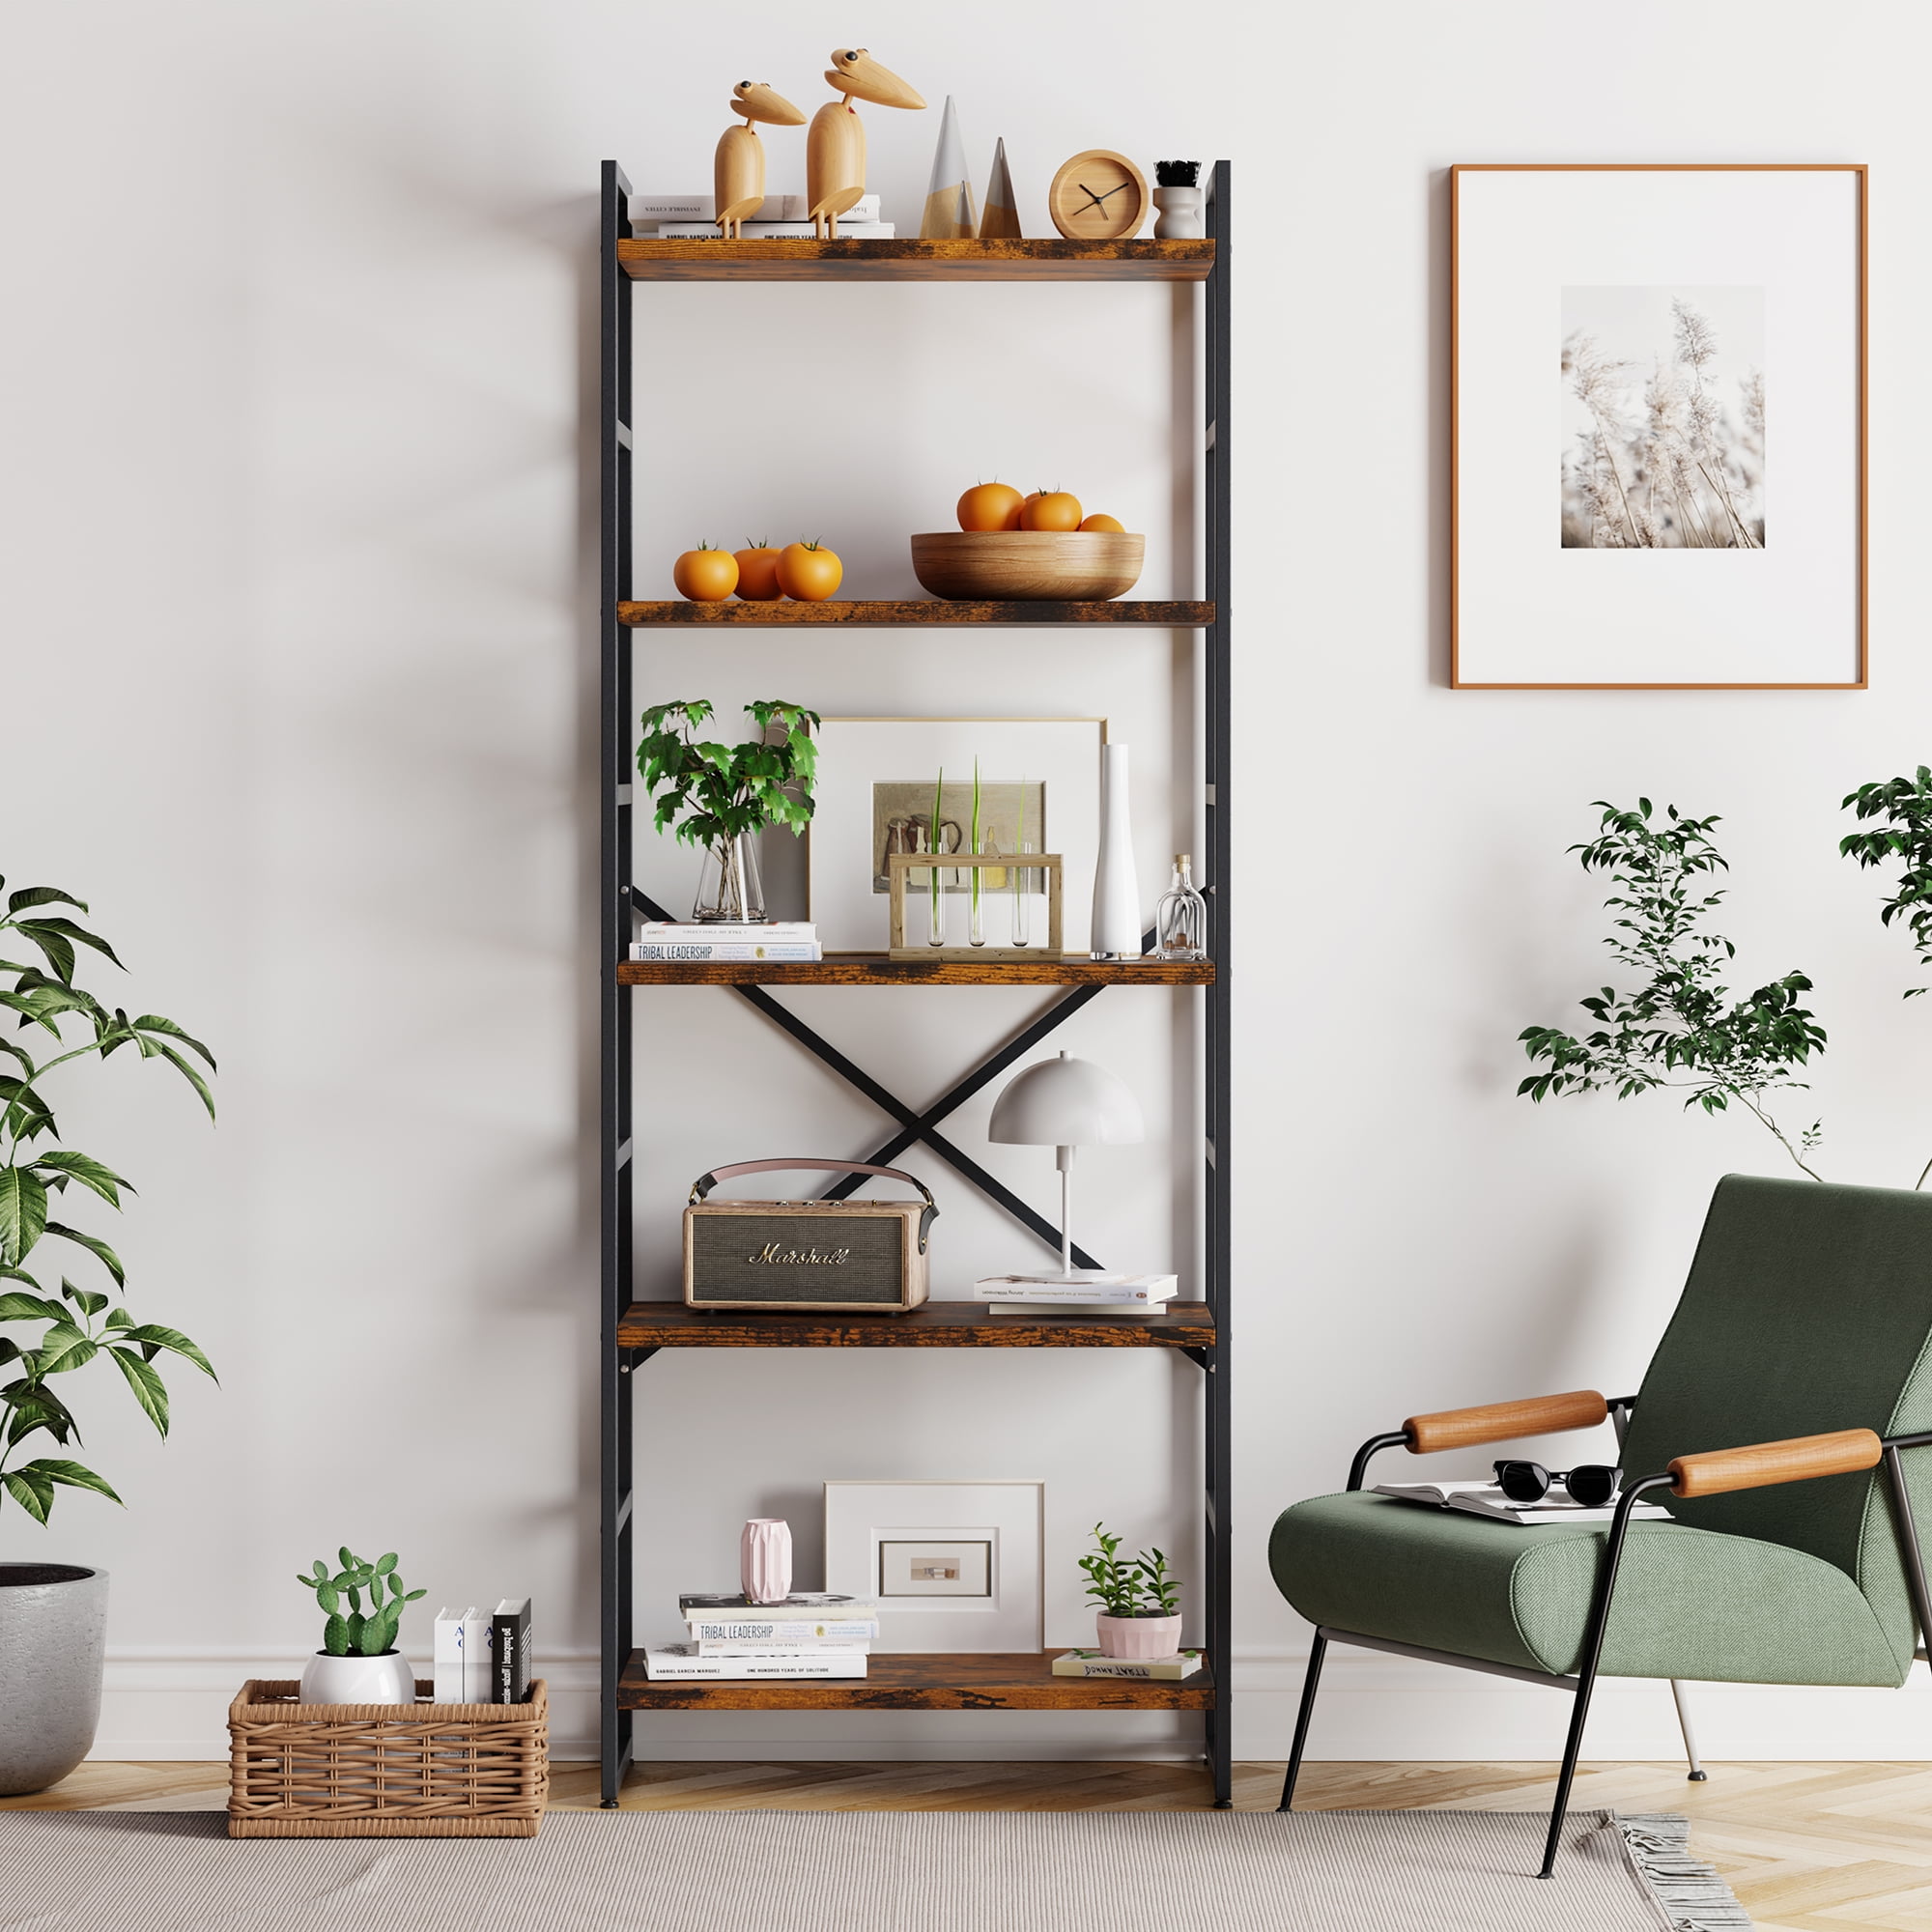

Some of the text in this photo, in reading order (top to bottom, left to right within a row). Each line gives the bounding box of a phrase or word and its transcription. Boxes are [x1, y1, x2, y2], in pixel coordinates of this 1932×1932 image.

[639, 945, 667, 960] TRIBAL
[667, 945, 713, 960] LEADERSHIP
[749, 1242, 850, 1265] Marshall
[700, 1625, 727, 1639] TRIBAL
[728, 1625, 774, 1639] LEADERSHIP
